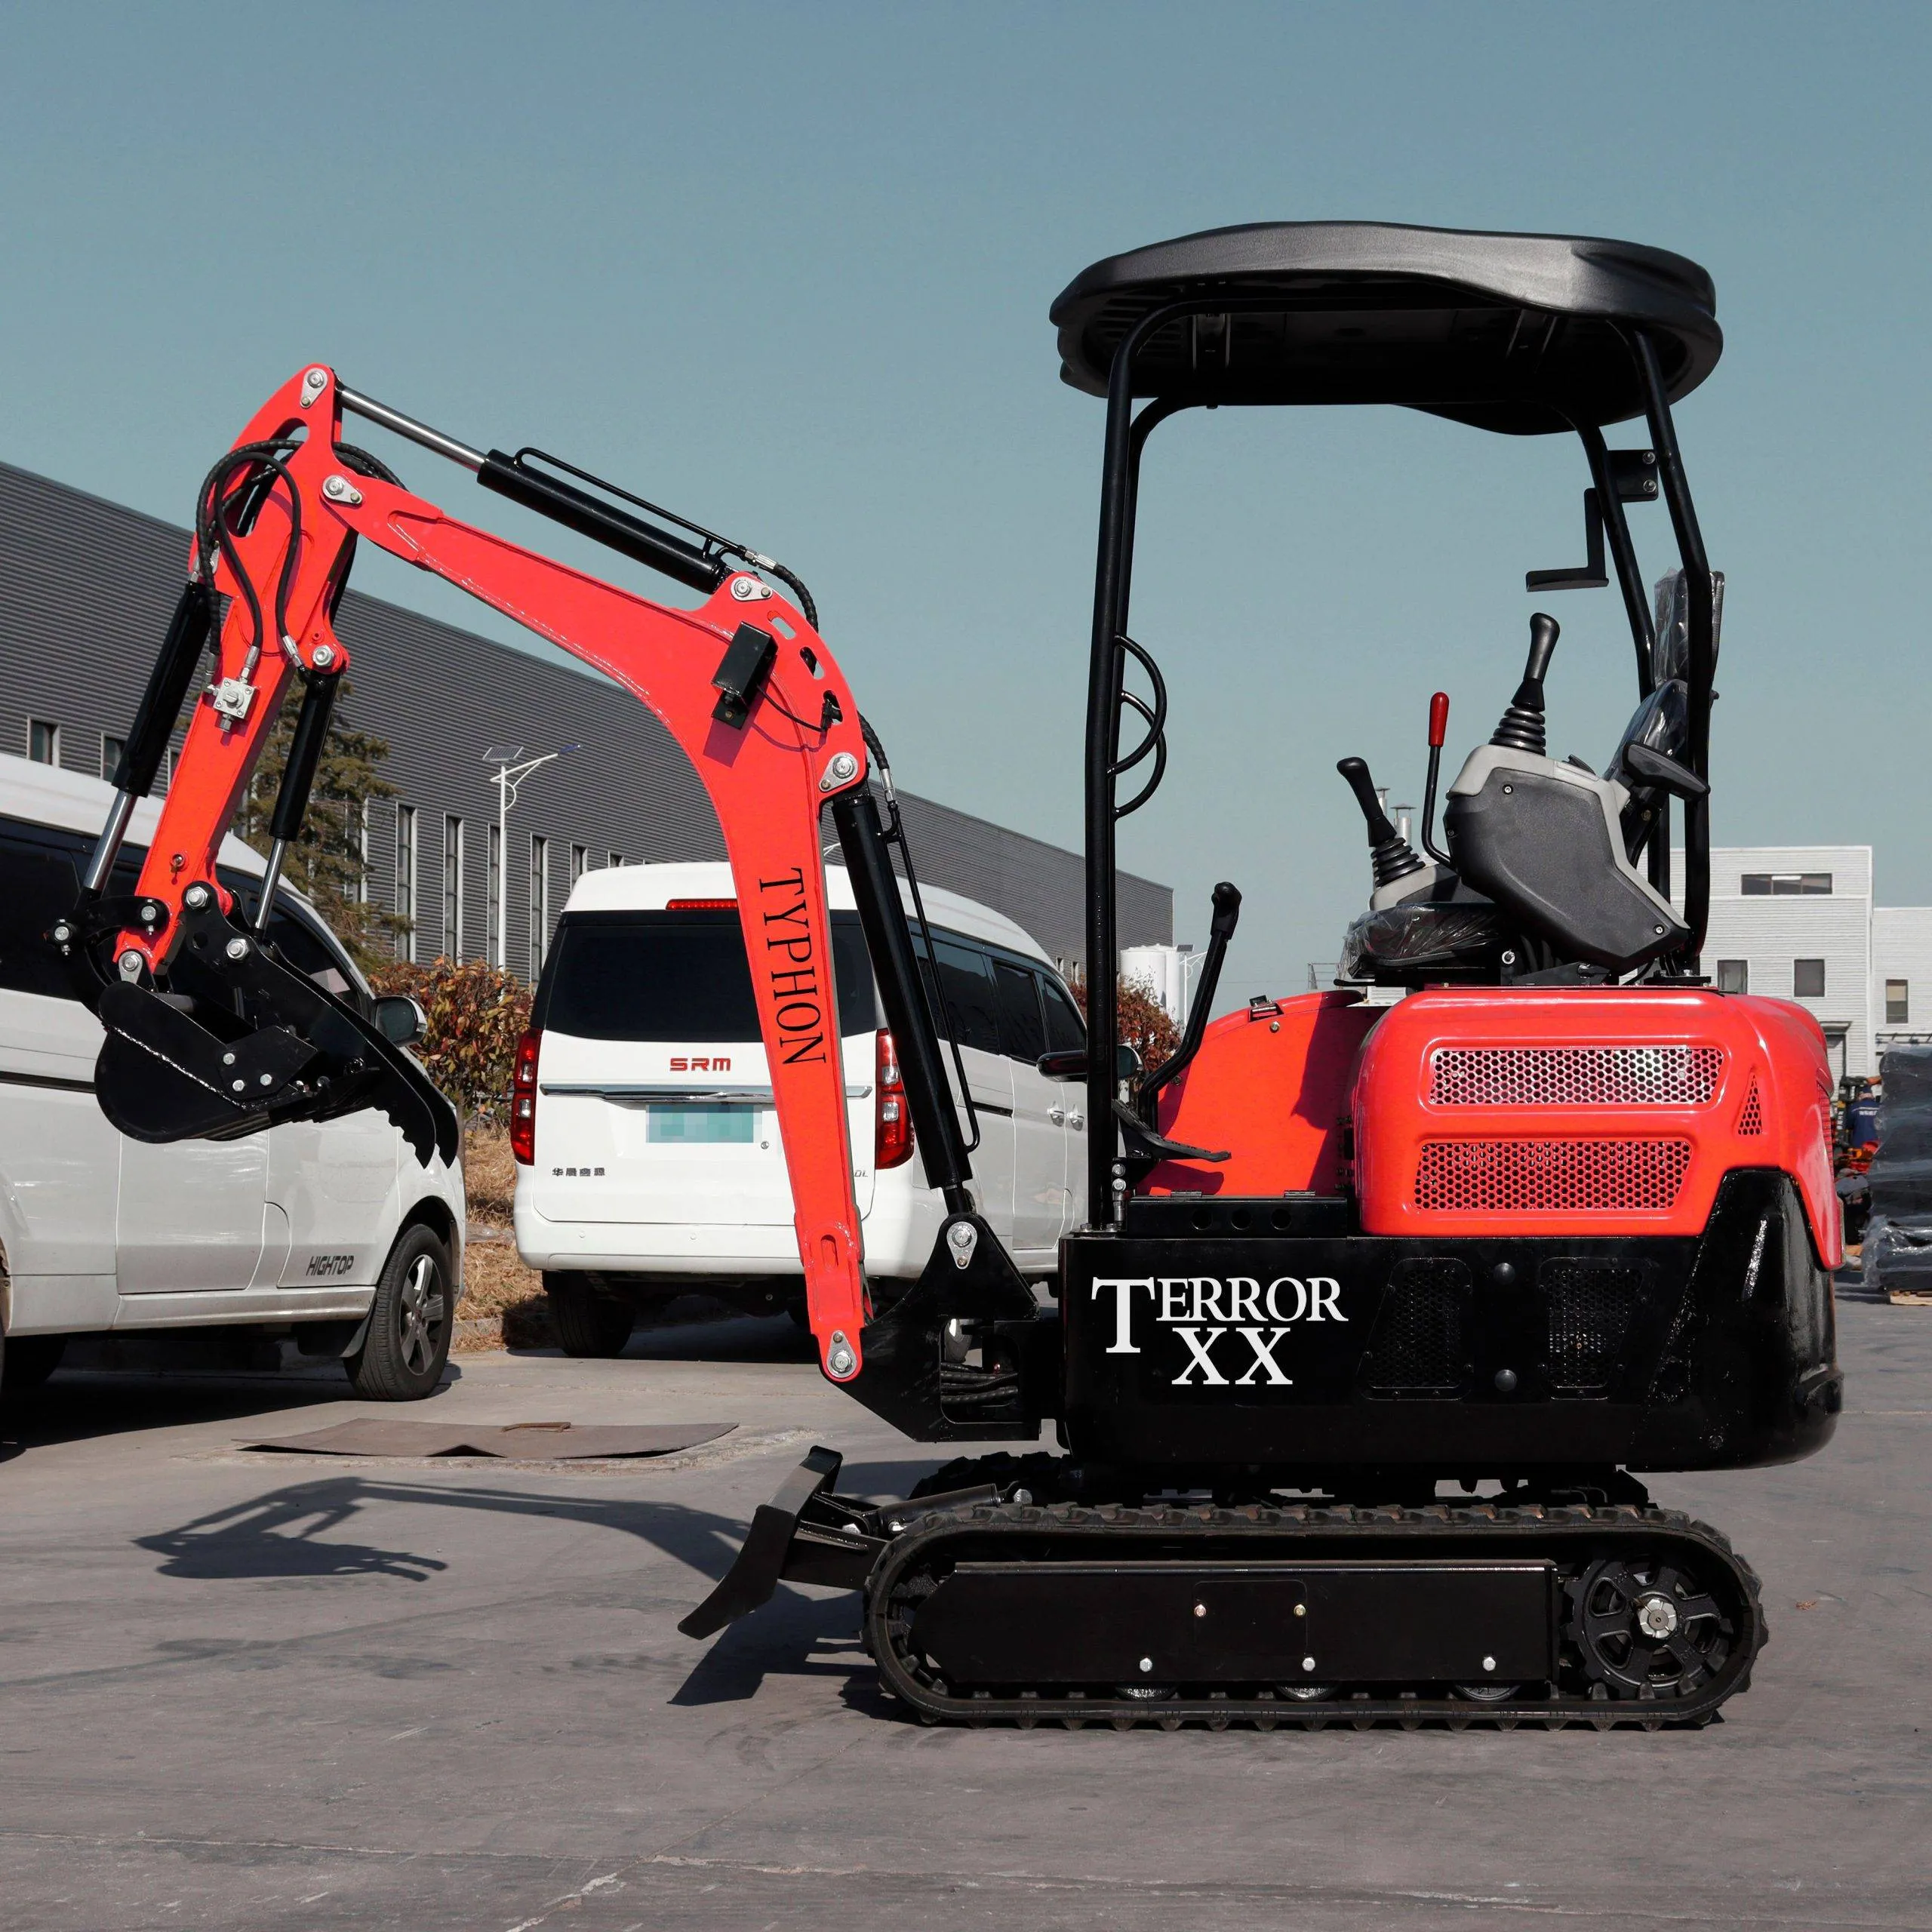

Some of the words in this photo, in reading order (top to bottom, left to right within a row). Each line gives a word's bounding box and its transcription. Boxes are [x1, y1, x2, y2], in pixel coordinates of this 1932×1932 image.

[759, 868, 826, 1064] TYPHON
[670, 1058, 731, 1071] SRM
[306, 1256, 354, 1276] HIGHTOP
[1091, 1277, 1349, 1353] TERROR
[1171, 1327, 1293, 1385] XX
